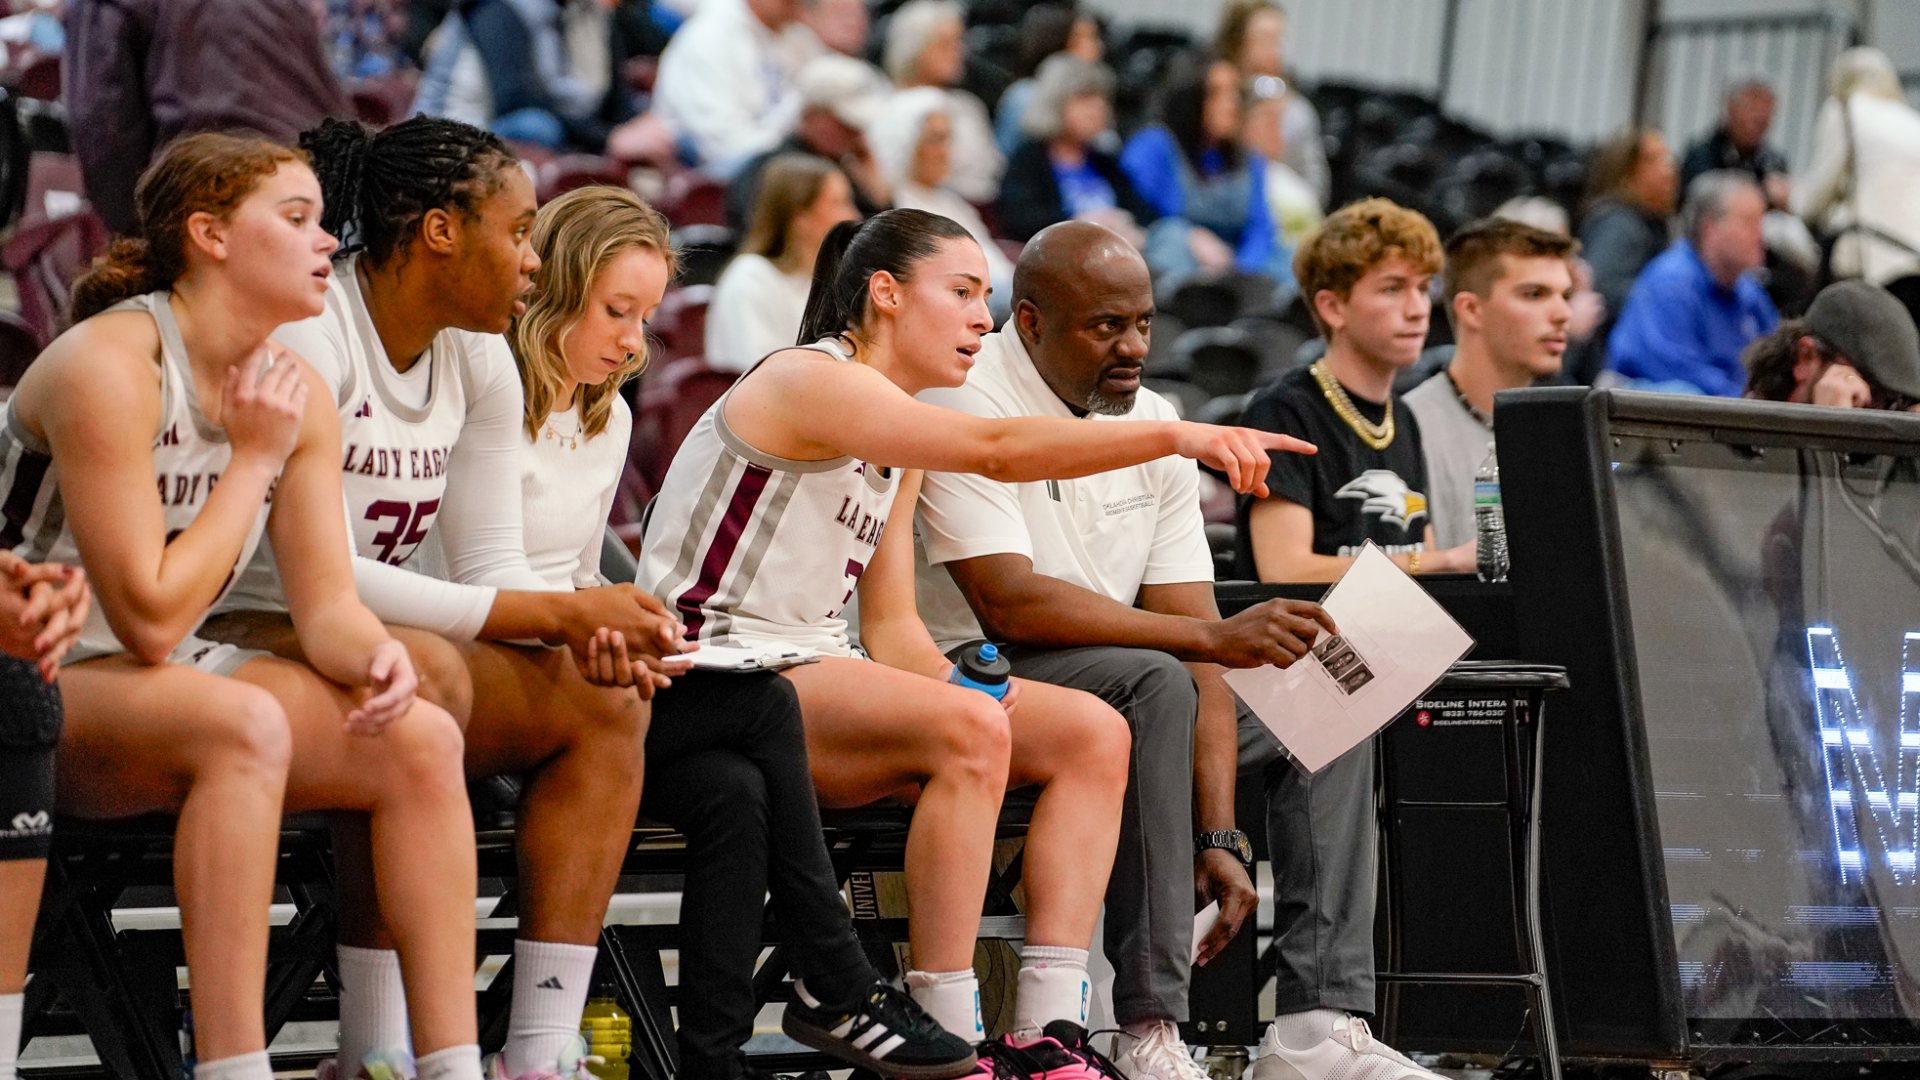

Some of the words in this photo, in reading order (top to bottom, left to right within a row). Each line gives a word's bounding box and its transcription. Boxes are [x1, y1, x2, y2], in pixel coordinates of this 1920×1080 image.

[342, 443, 402, 478] LADY
[157, 472, 202, 506] ADY
[1127, 493, 1155, 505] CHRISTIAN
[1415, 699, 1465, 710] SIDELINE
[1442, 710, 1465, 718] (832)
[1467, 709, 1506, 718] 786-030
